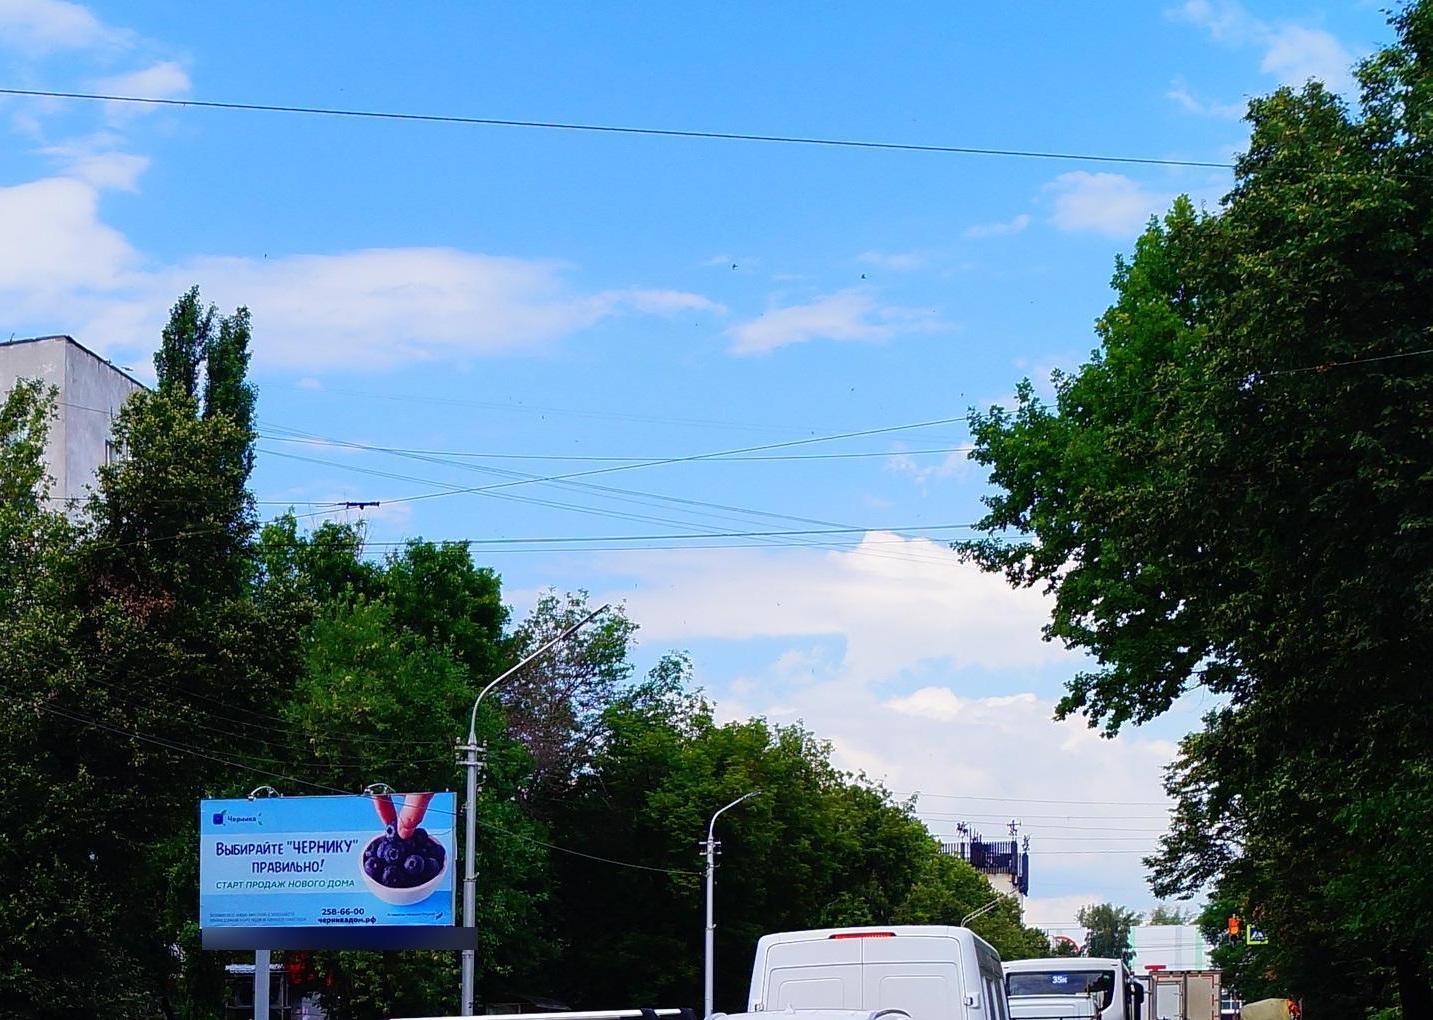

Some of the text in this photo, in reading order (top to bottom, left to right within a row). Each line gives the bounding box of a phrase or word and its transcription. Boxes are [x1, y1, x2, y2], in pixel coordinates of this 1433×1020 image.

[287, 839, 359, 854] "ЧЕРНИКУ"
[252, 858, 325, 873] ПРАВИЛЬНО!
[216, 879, 355, 890] СТАРТ ПРОДАЖ НОВОГО ДОМА
[321, 908, 365, 916] 258-66-00
